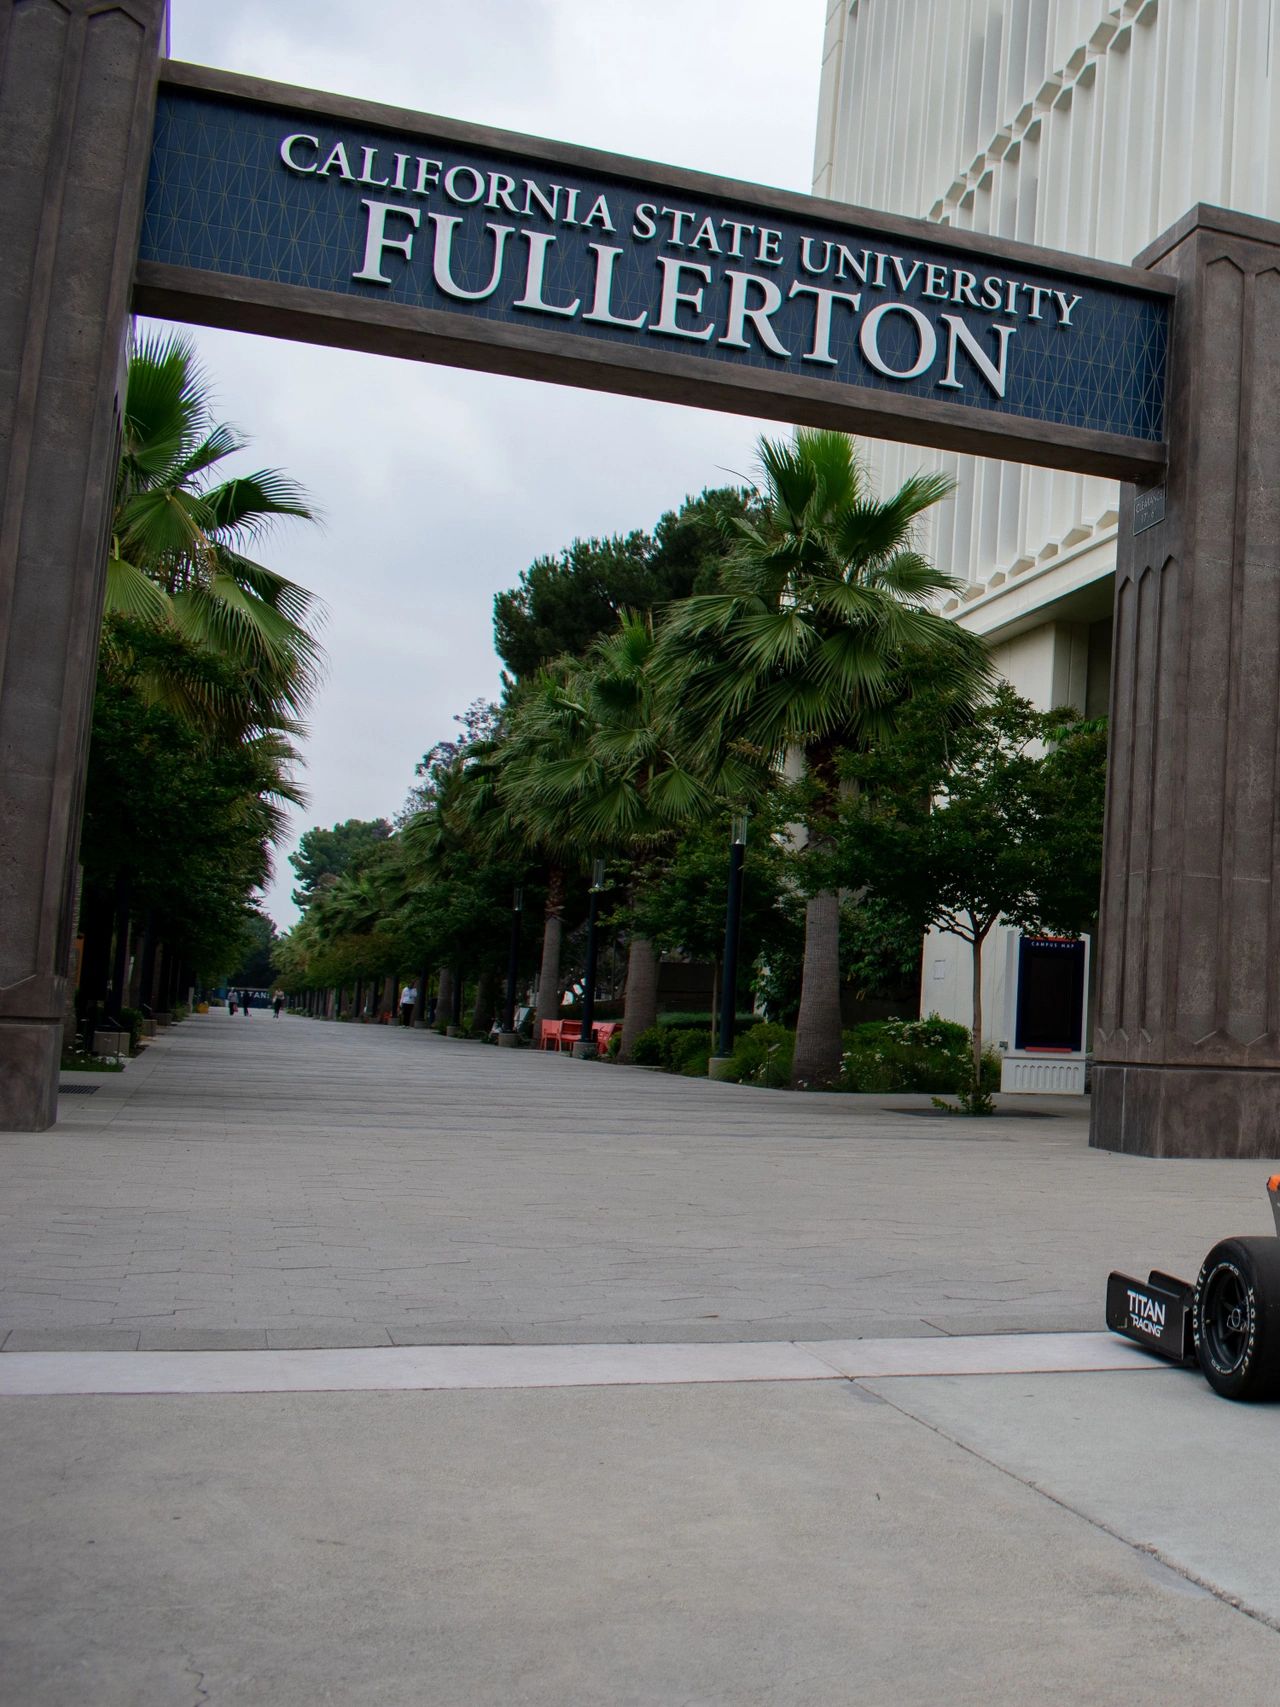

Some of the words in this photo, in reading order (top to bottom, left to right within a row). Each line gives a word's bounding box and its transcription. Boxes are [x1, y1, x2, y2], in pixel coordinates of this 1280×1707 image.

[280, 134, 617, 232] CALIFORNIA
[633, 203, 784, 265] STATE
[801, 236, 1082, 327] UNIVERSITY
[352, 198, 1017, 398] FULLERTON
[1127, 1289, 1166, 1326] TITAN
[1130, 1313, 1163, 1338] RACING
